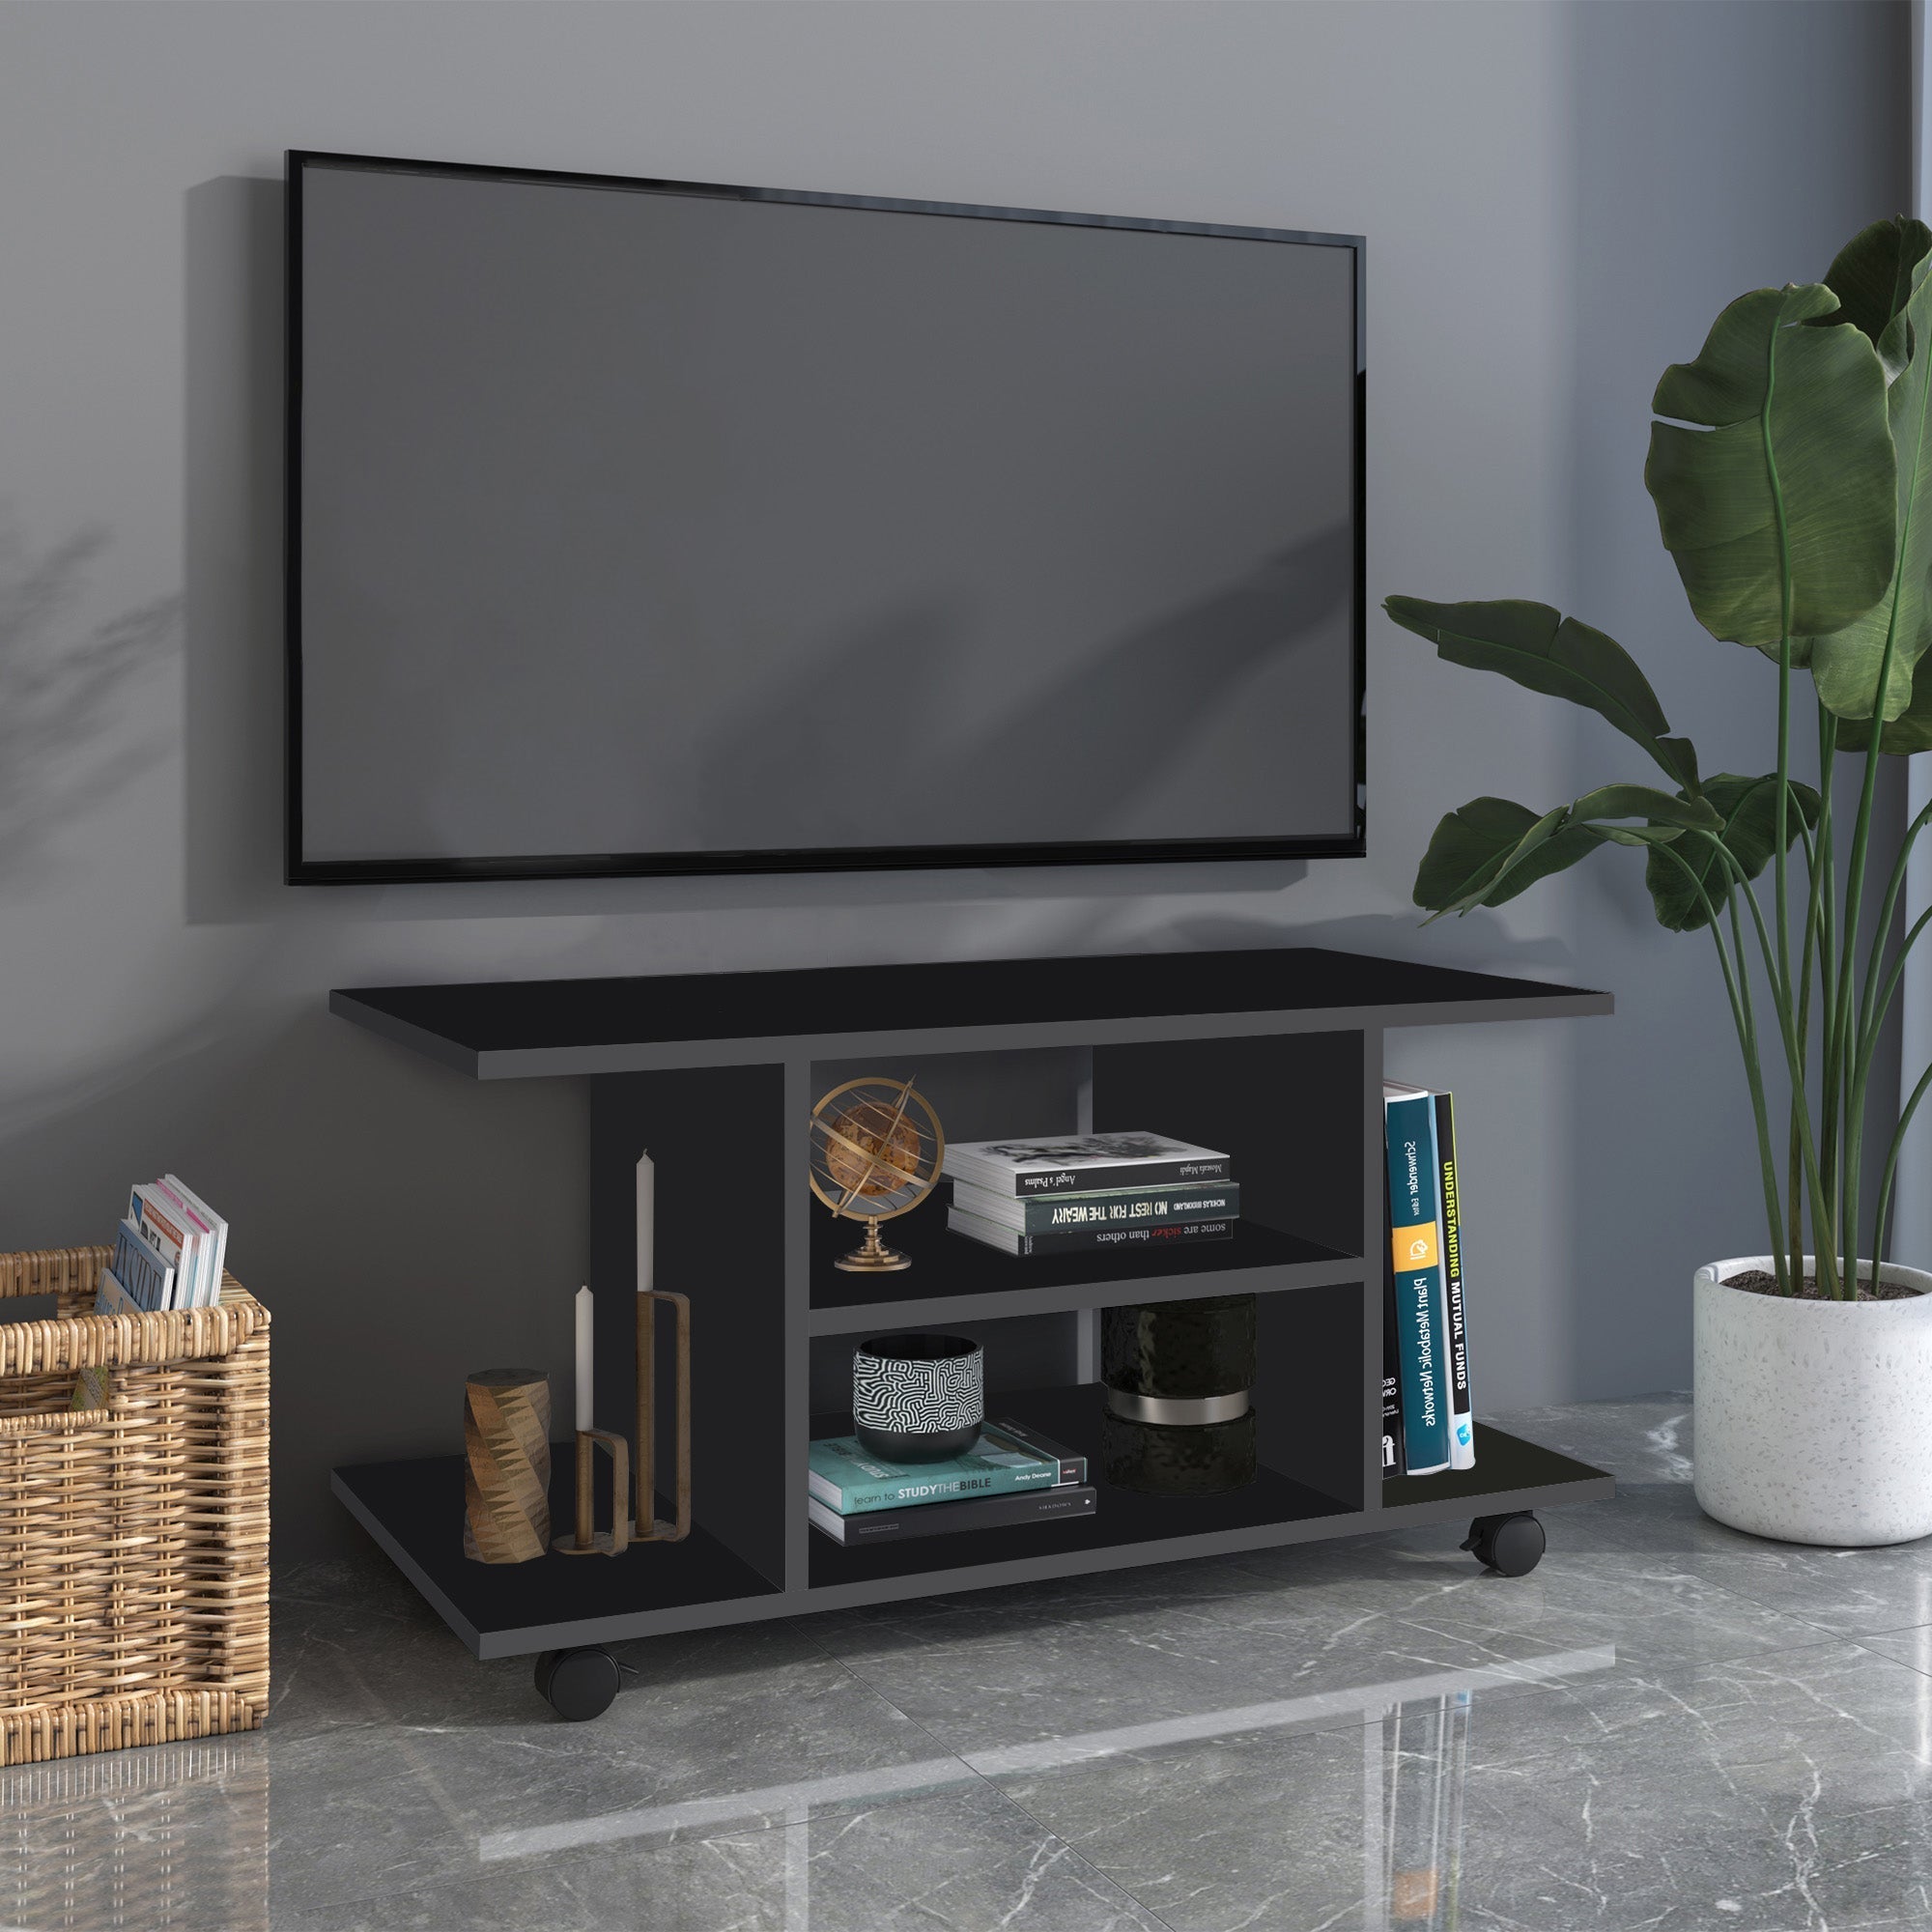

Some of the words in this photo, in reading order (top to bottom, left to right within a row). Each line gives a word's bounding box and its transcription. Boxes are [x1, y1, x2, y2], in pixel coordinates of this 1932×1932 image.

[1025, 1178, 1048, 1188] Psalms
[1089, 1207, 1107, 1221] THE
[1110, 1204, 1127, 1219] FOR
[1129, 1202, 1152, 1217] REST
[1154, 1201, 1168, 1215] NO
[1052, 1207, 1089, 1224] WEARY
[1443, 1161, 1460, 1278] UNDERSTANDING
[1151, 1228, 1181, 1238] sicker
[1183, 1226, 1199, 1235] are
[1201, 1223, 1227, 1233] some
[1096, 1231, 1126, 1243] others
[1128, 1230, 1150, 1240] than
[1451, 1282, 1463, 1340] MUTUAL
[1455, 1344, 1466, 1390] FUNDS
[1014, 1473, 1031, 1483] Andy
[1032, 1471, 1052, 1480] Deane
[854, 1494, 882, 1505] learn
[884, 1492, 895, 1501] to
